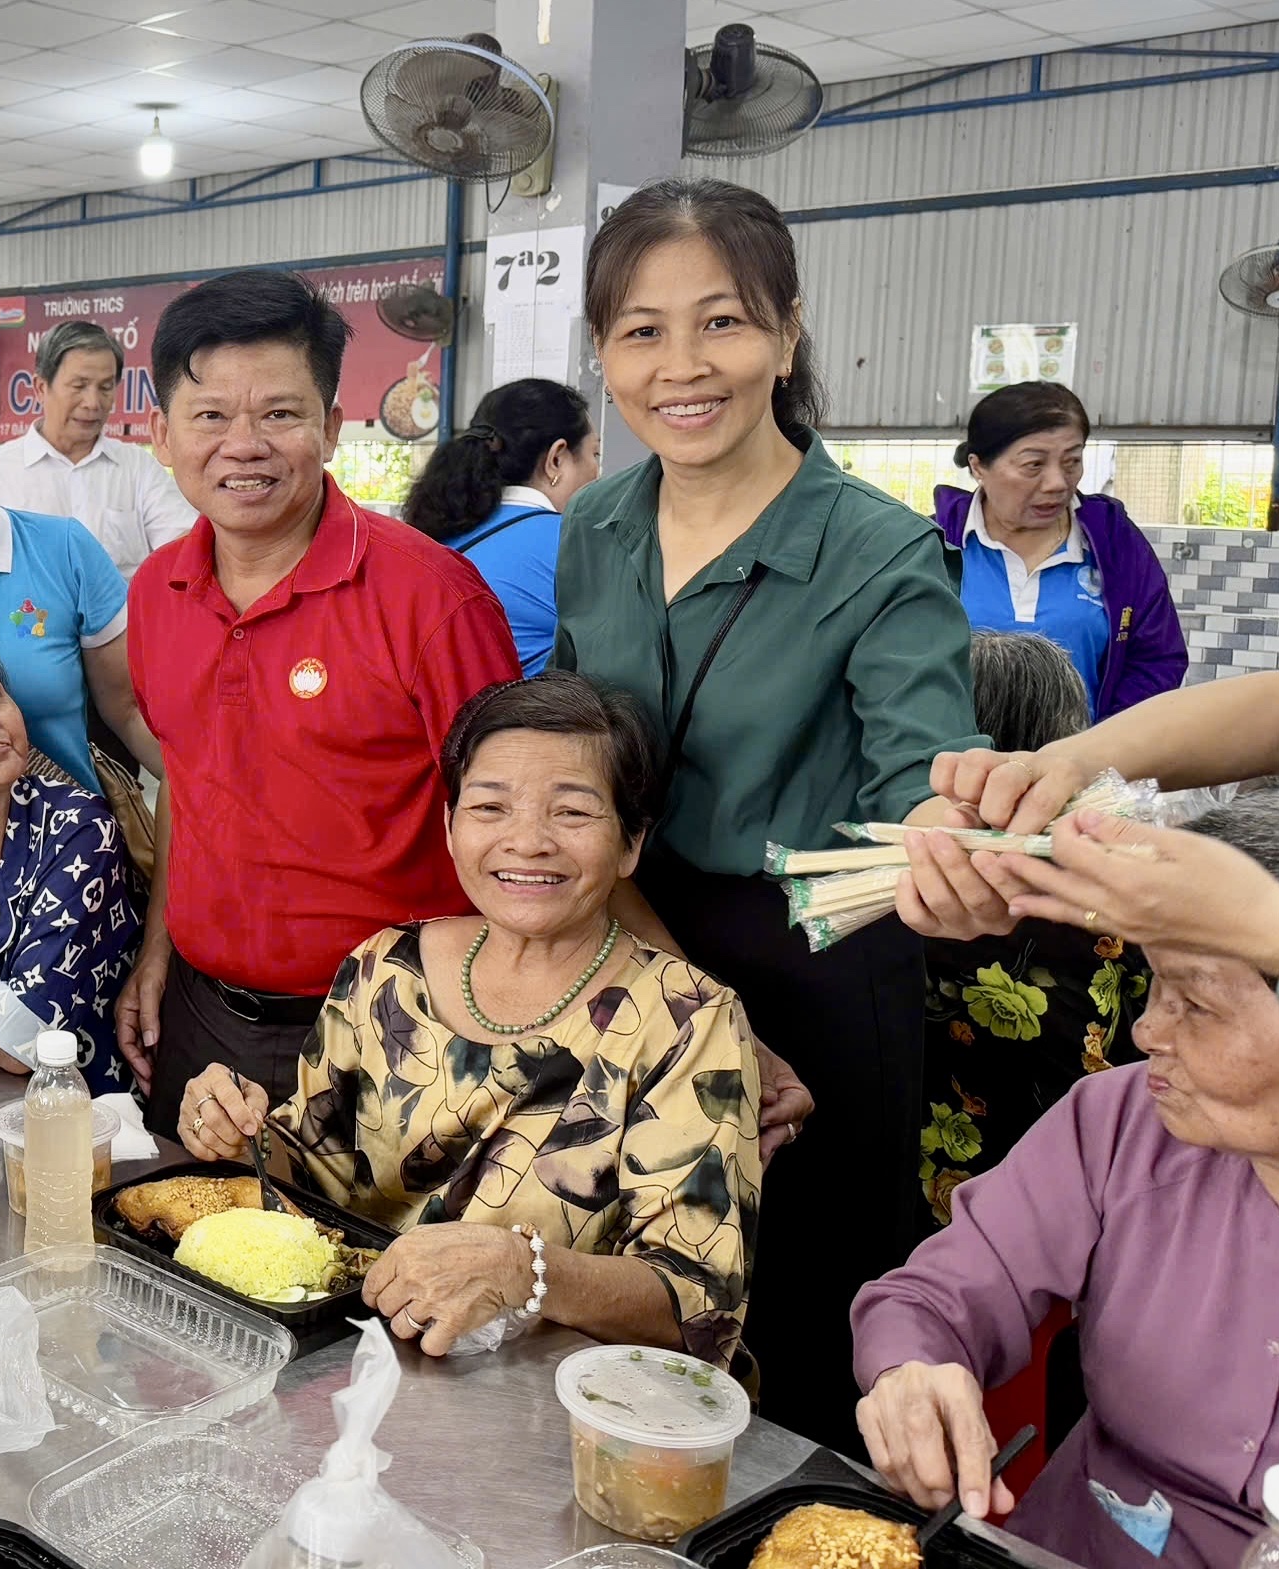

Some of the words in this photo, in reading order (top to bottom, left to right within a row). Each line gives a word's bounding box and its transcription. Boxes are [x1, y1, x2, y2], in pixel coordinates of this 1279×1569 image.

[346, 278, 369, 302] trên
[44, 297, 90, 317] TRƯỜNG
[93, 297, 125, 314] THCS
[123, 366, 161, 414] IN
